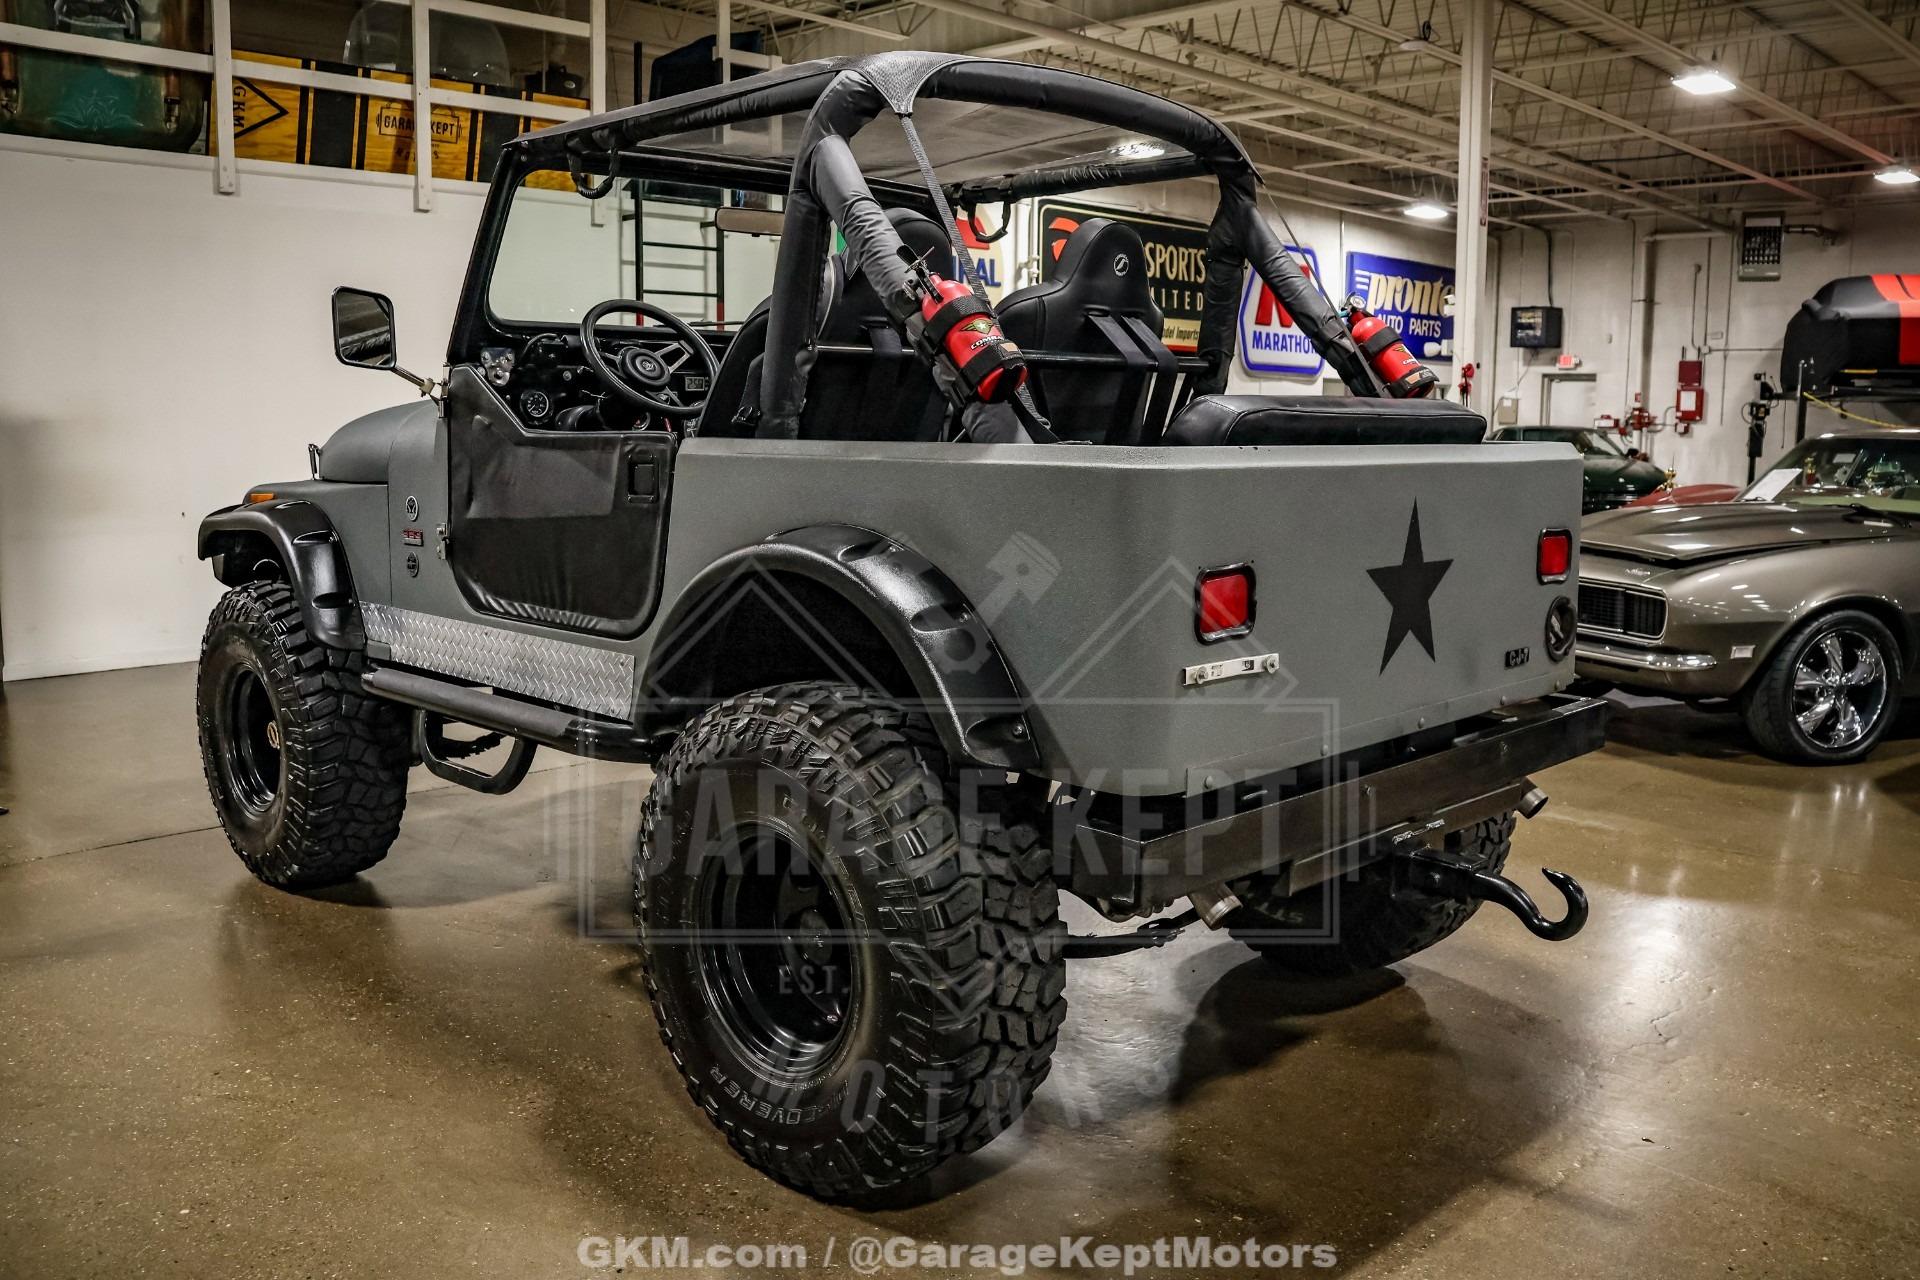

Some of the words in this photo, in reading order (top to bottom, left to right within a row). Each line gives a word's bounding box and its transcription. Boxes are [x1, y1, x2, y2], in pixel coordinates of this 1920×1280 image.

[1144, 241, 1207, 284] SPORTS
[1408, 317, 1442, 339] PARTS
[1252, 330, 1317, 355] MARATHO
